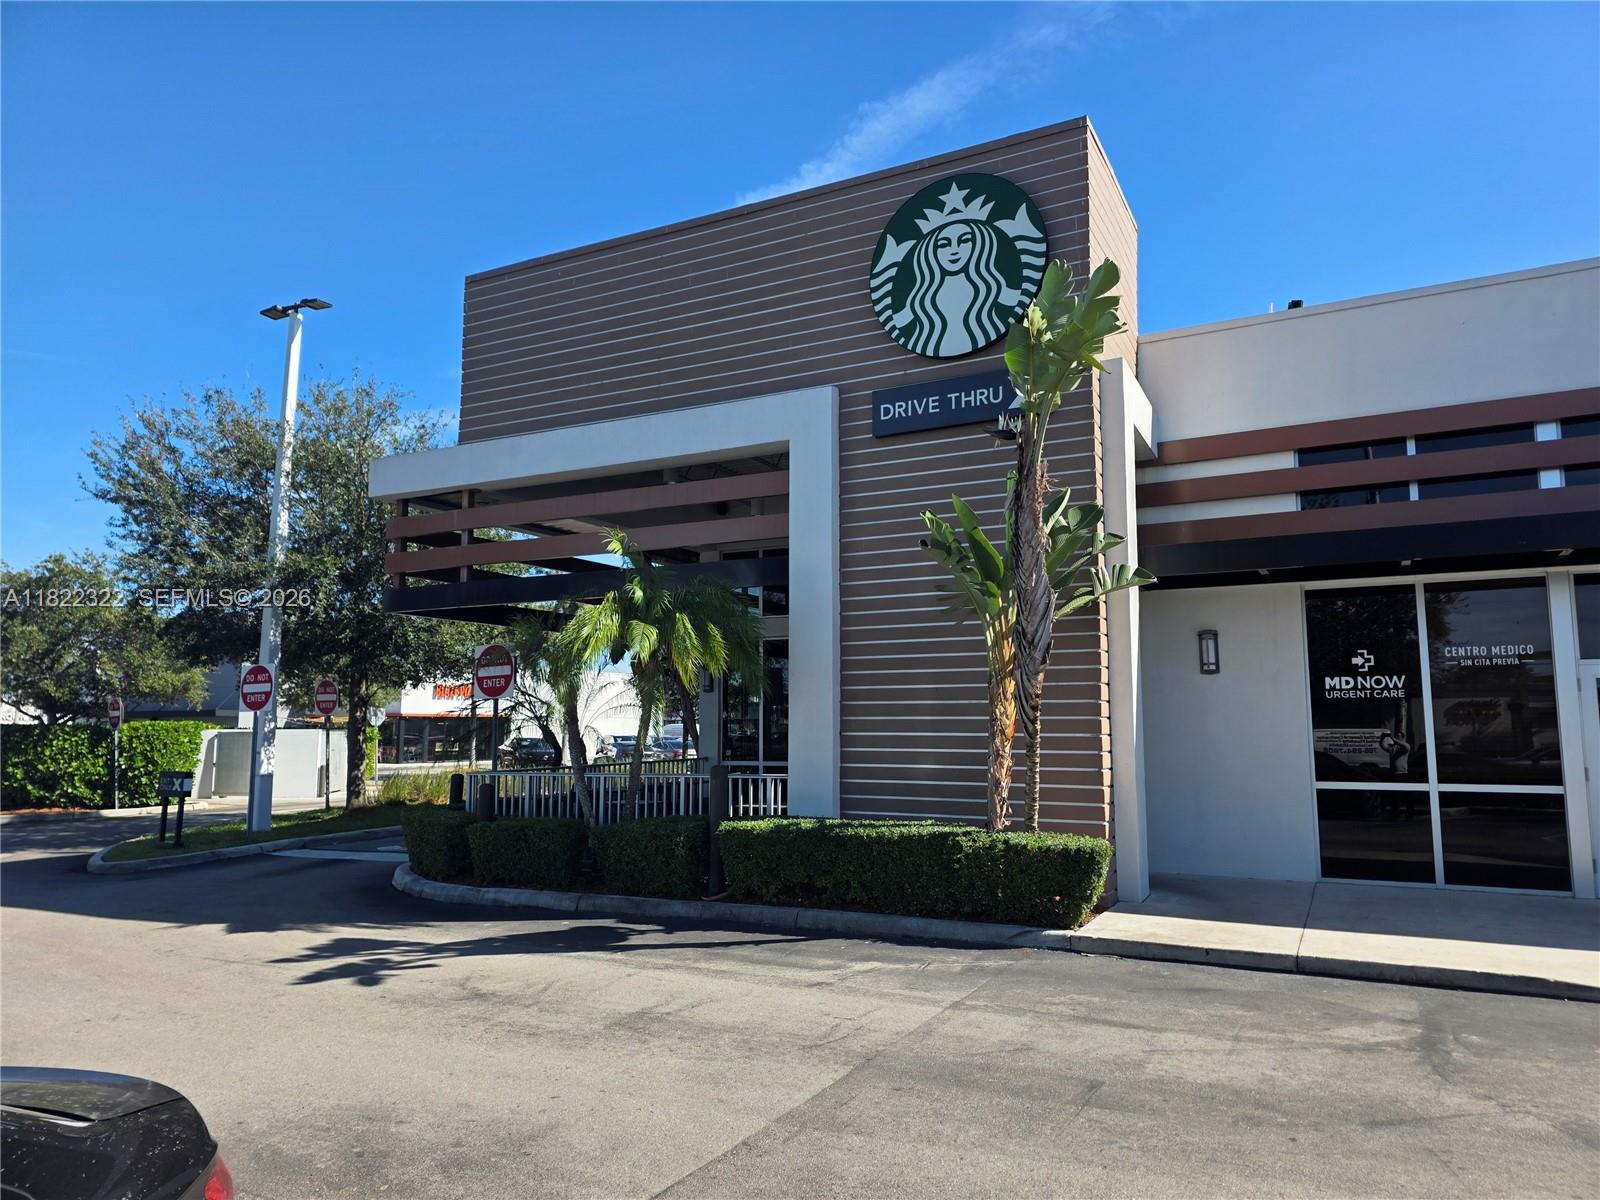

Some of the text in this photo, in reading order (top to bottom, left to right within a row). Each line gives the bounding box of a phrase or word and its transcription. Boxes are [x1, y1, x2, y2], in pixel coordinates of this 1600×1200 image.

[880, 386, 1003, 420] DRIVE THRU
[1445, 644, 1534, 656] CENTRO MEDICO
[1493, 658, 1520, 666] PREVIA
[258, 673, 269, 682] NOT
[1325, 675, 1405, 690] MD NOW
[483, 678, 505, 688] ENTER
[247, 693, 266, 703] ENTER
[1326, 689, 1405, 699] URGENT CARE
